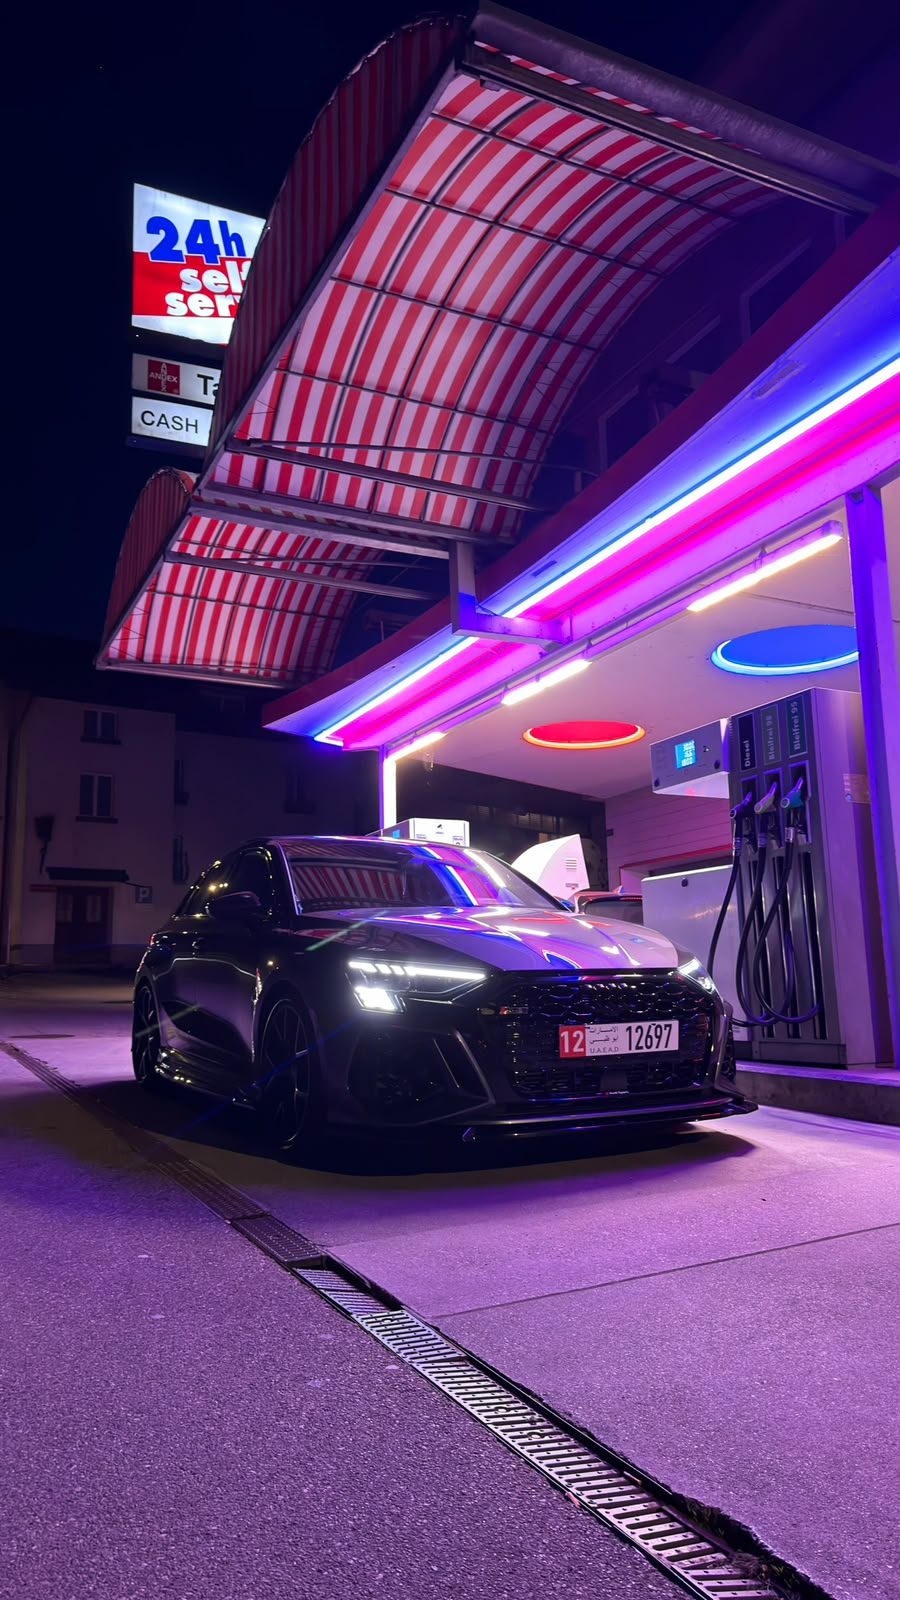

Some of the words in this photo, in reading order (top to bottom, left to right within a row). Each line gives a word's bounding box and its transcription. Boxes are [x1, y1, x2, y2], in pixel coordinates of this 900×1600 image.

[146, 216, 246, 264] 24h
[141, 410, 198, 434] CASH
[792, 715, 801, 751] Bleifrei
[743, 740, 751, 768] Diesel
[560, 1030, 585, 1053] 12
[626, 1023, 673, 1051] 12697
